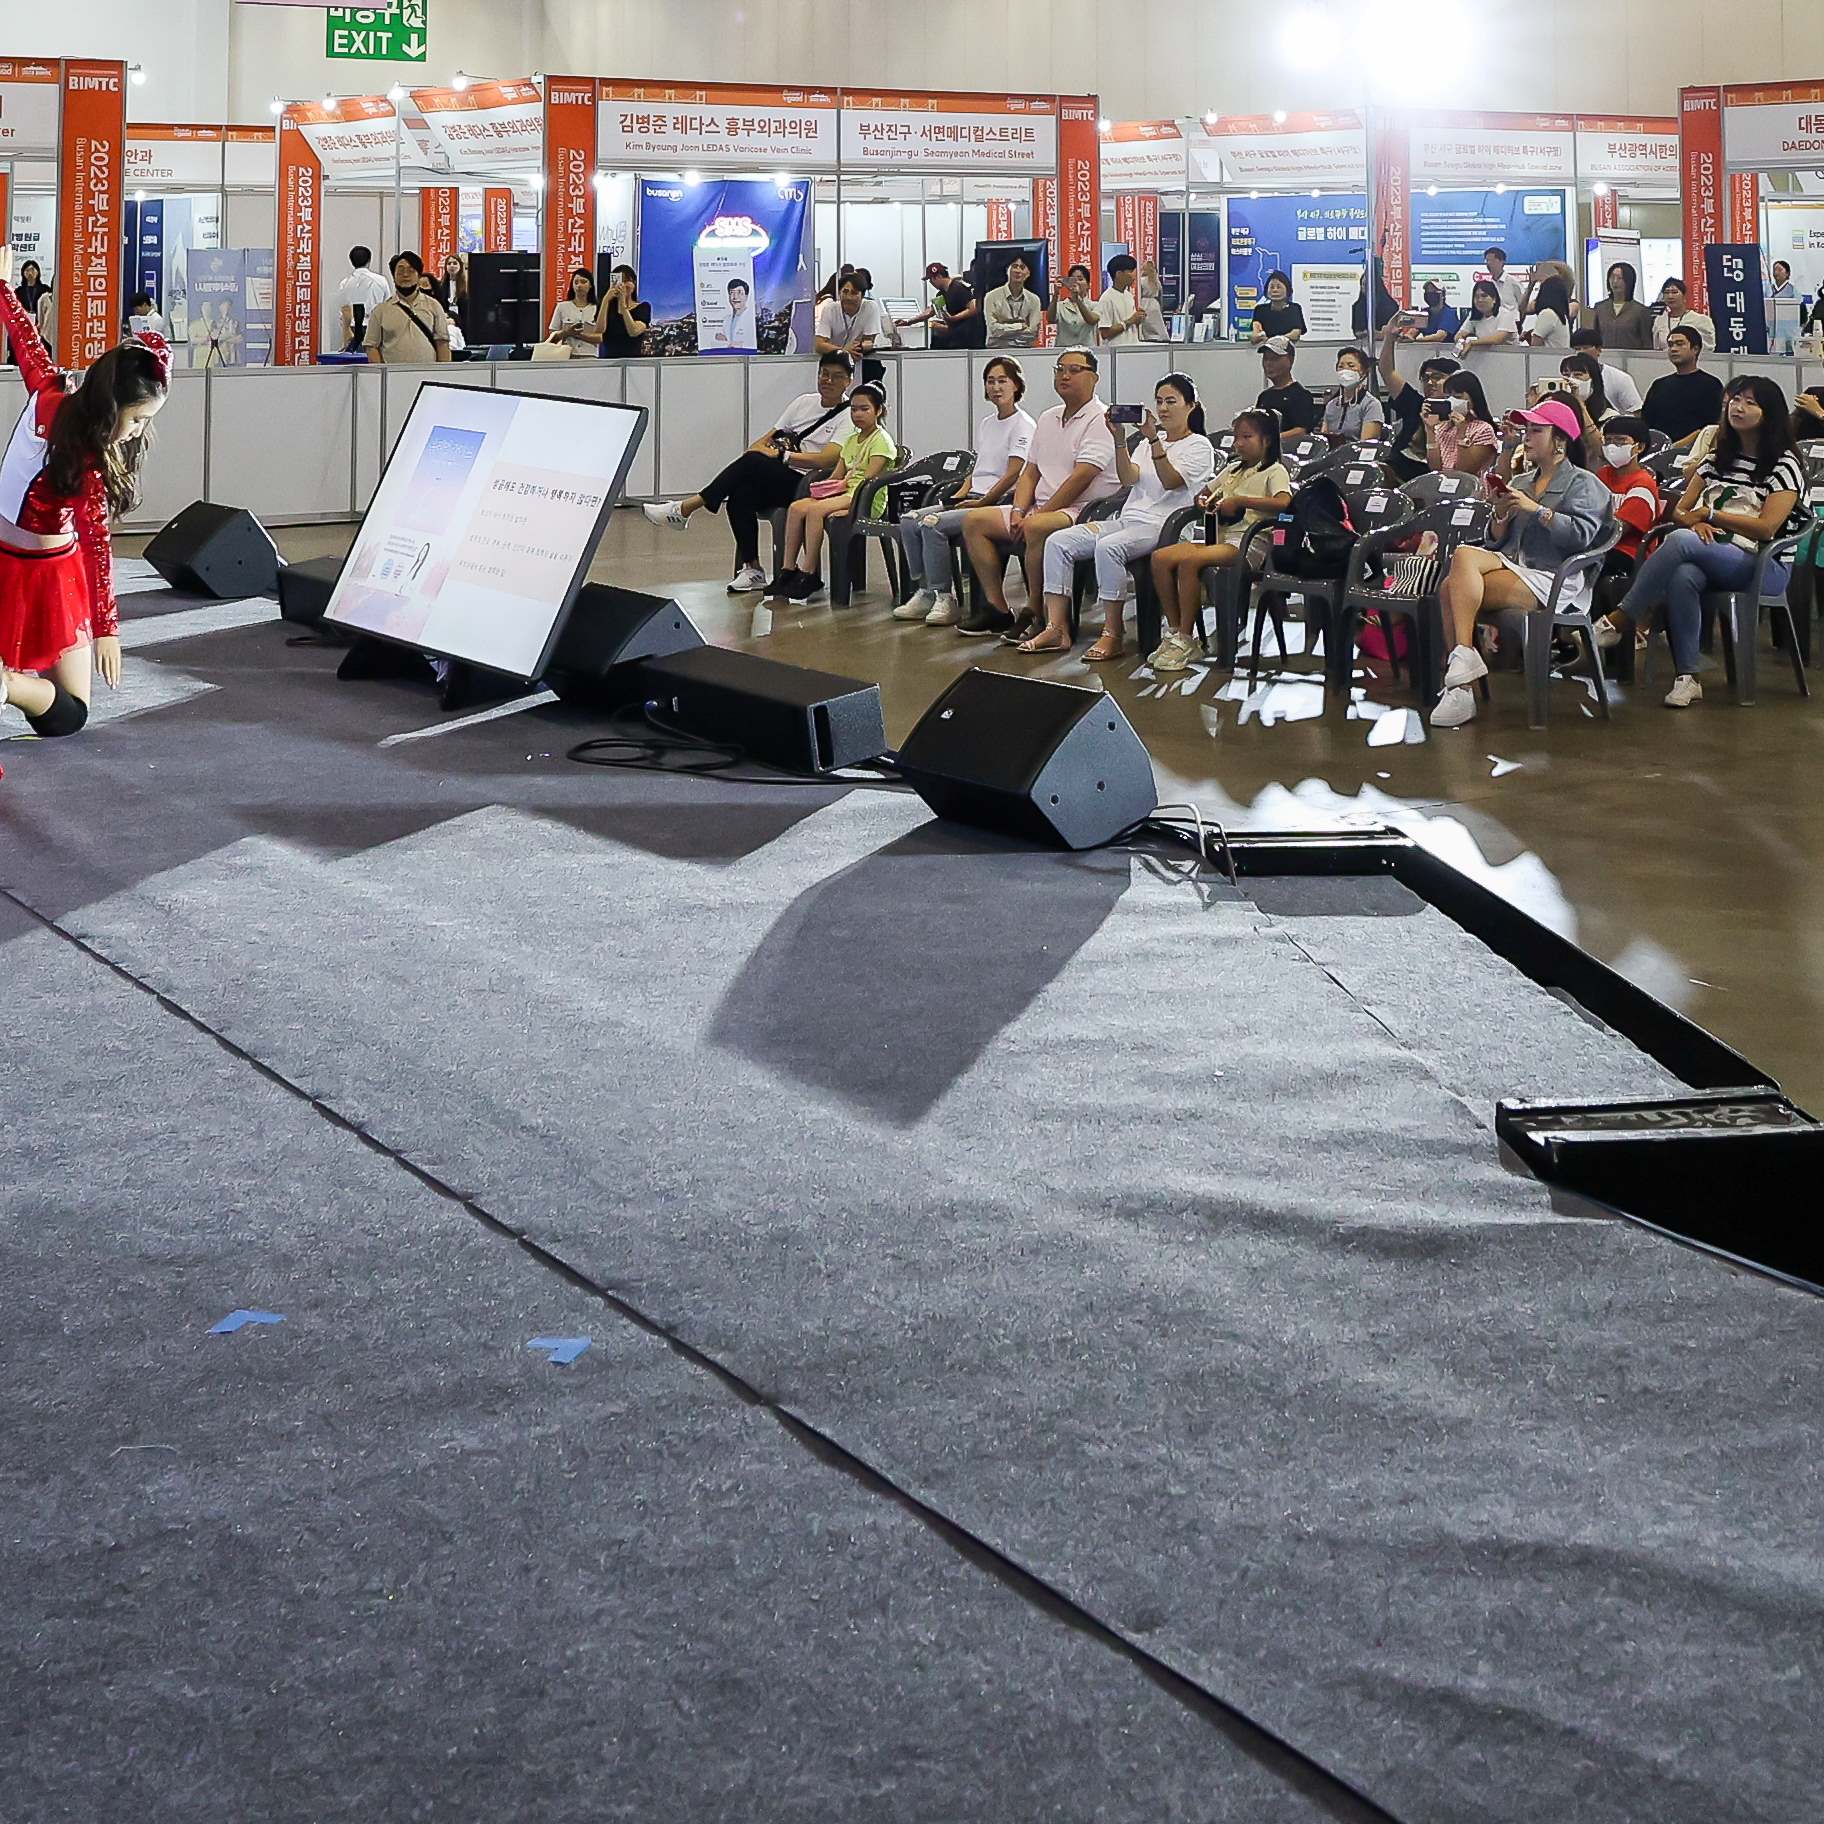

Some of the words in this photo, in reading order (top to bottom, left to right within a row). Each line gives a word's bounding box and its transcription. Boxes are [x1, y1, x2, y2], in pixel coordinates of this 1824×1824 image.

[334, 31, 393, 55] EXIT
[69, 75, 119, 92] BIMTC
[551, 92, 592, 104] BIMTC
[1683, 99, 1717, 111] BIMTC
[618, 113, 668, 135] 김병준
[672, 114, 721, 136] 레다스
[725, 116, 819, 139] 흉부외과의원
[1061, 108, 1094, 121] BIMTC
[77, 137, 87, 171] Busan
[625, 142, 644, 151] Kim
[702, 144, 731, 153] LEDAS
[790, 146, 812, 155] Clinic
[863, 147, 919, 160] Busanjin-gu
[972, 148, 1006, 159] Medical
[1008, 149, 1034, 159] Street
[133, 168, 174, 178] CENTER
[287, 165, 296, 190] Busan
[73, 173, 85, 240] International
[287, 192, 295, 244] International
[557, 179, 566, 241] International
[1690, 181, 1699, 239] International
[1327, 227, 1347, 241] 하이
[72, 242, 82, 288] Medical
[286, 246, 294, 277] Medical
[556, 244, 565, 282] Medical
[71, 289, 81, 333] Tourism
